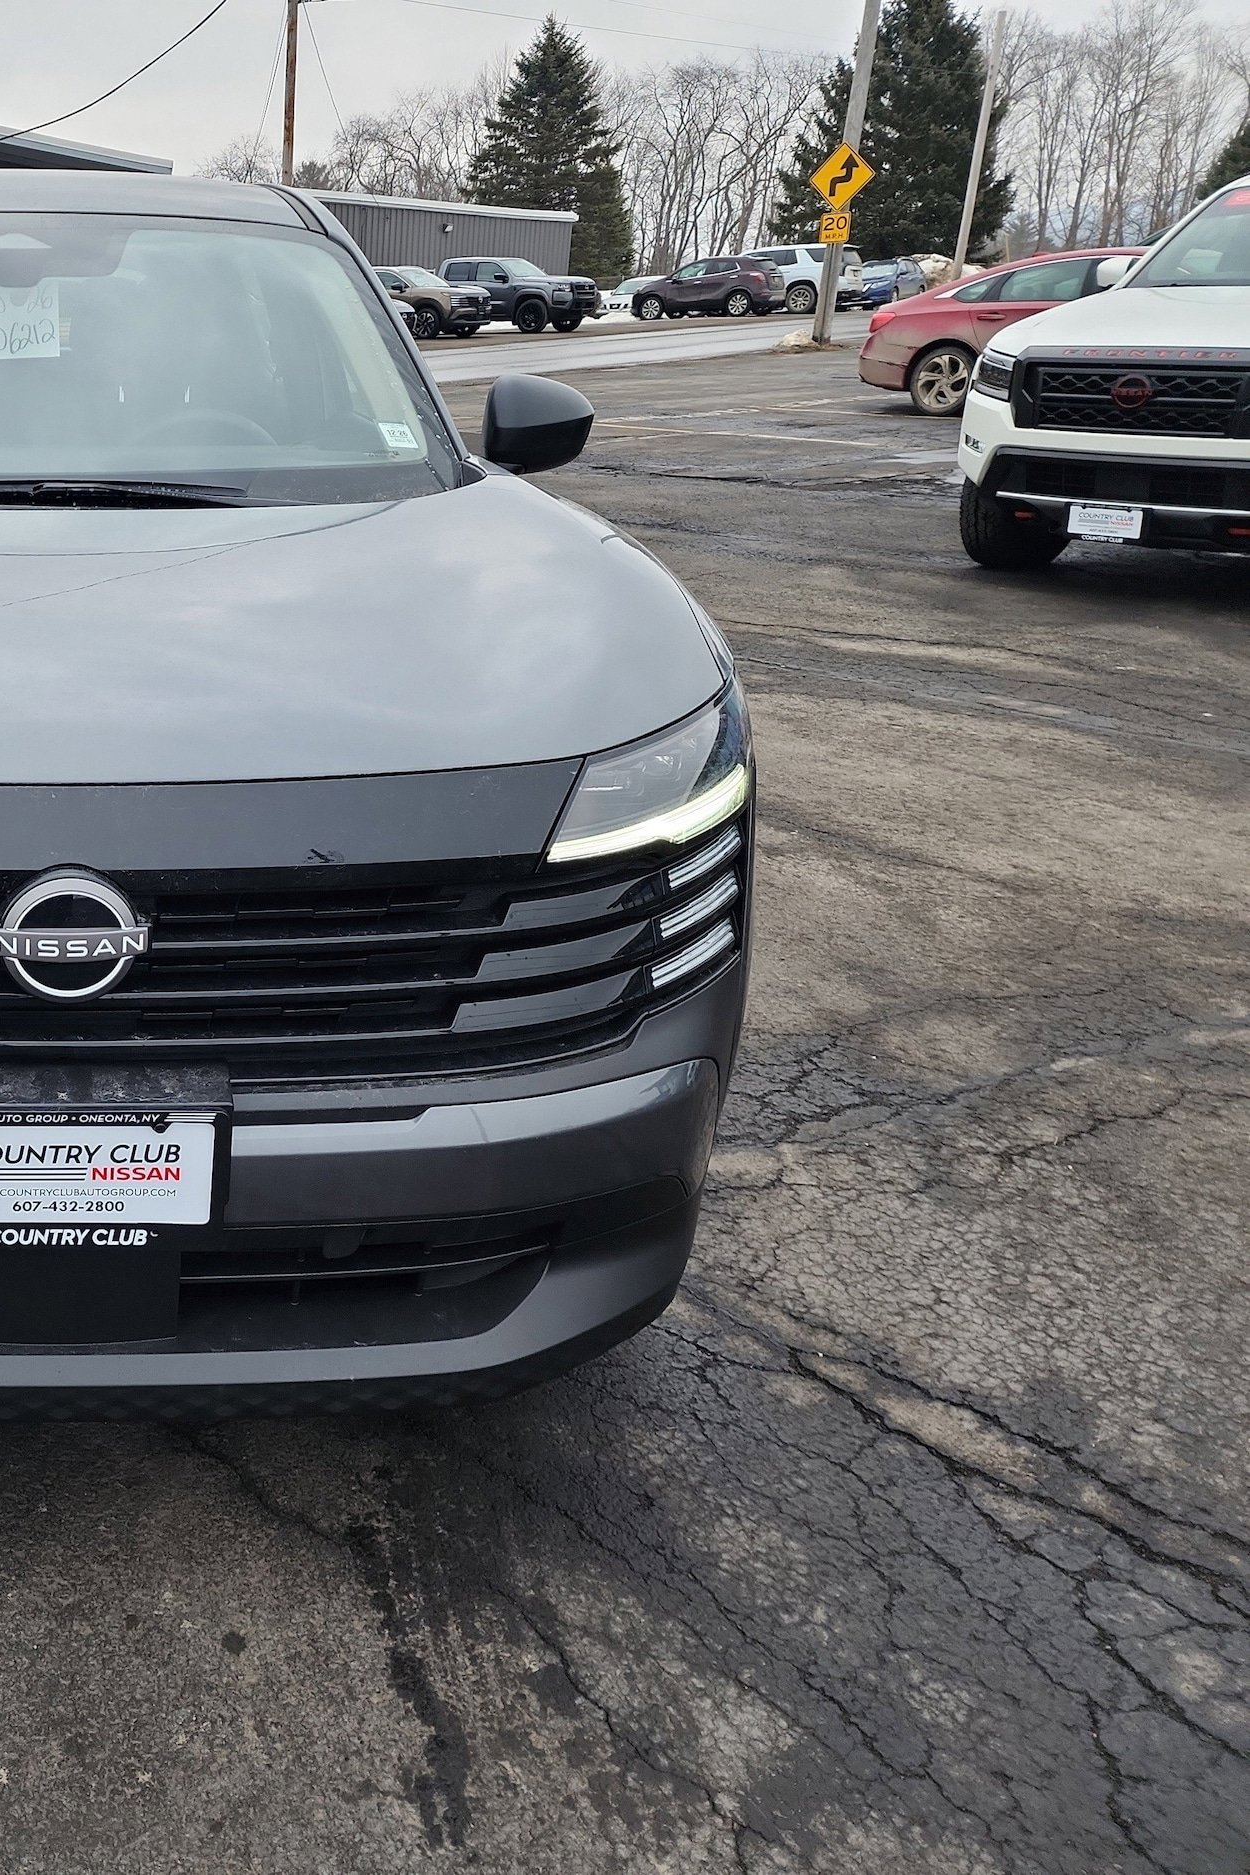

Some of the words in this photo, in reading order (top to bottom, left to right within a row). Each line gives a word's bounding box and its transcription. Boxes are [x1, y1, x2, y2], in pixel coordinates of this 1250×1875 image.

[824, 216, 847, 231] 20
[1063, 349, 1237, 359] FRONTIER
[1078, 512, 1114, 520] COUNTRY
[26, 1114, 69, 1123] GROUP
[109, 1144, 181, 1164] CLUB
[91, 1167, 181, 1181] NISSAN
[12, 1200, 125, 1213] 607-432-2800
[91, 1229, 148, 1246] CLUB
